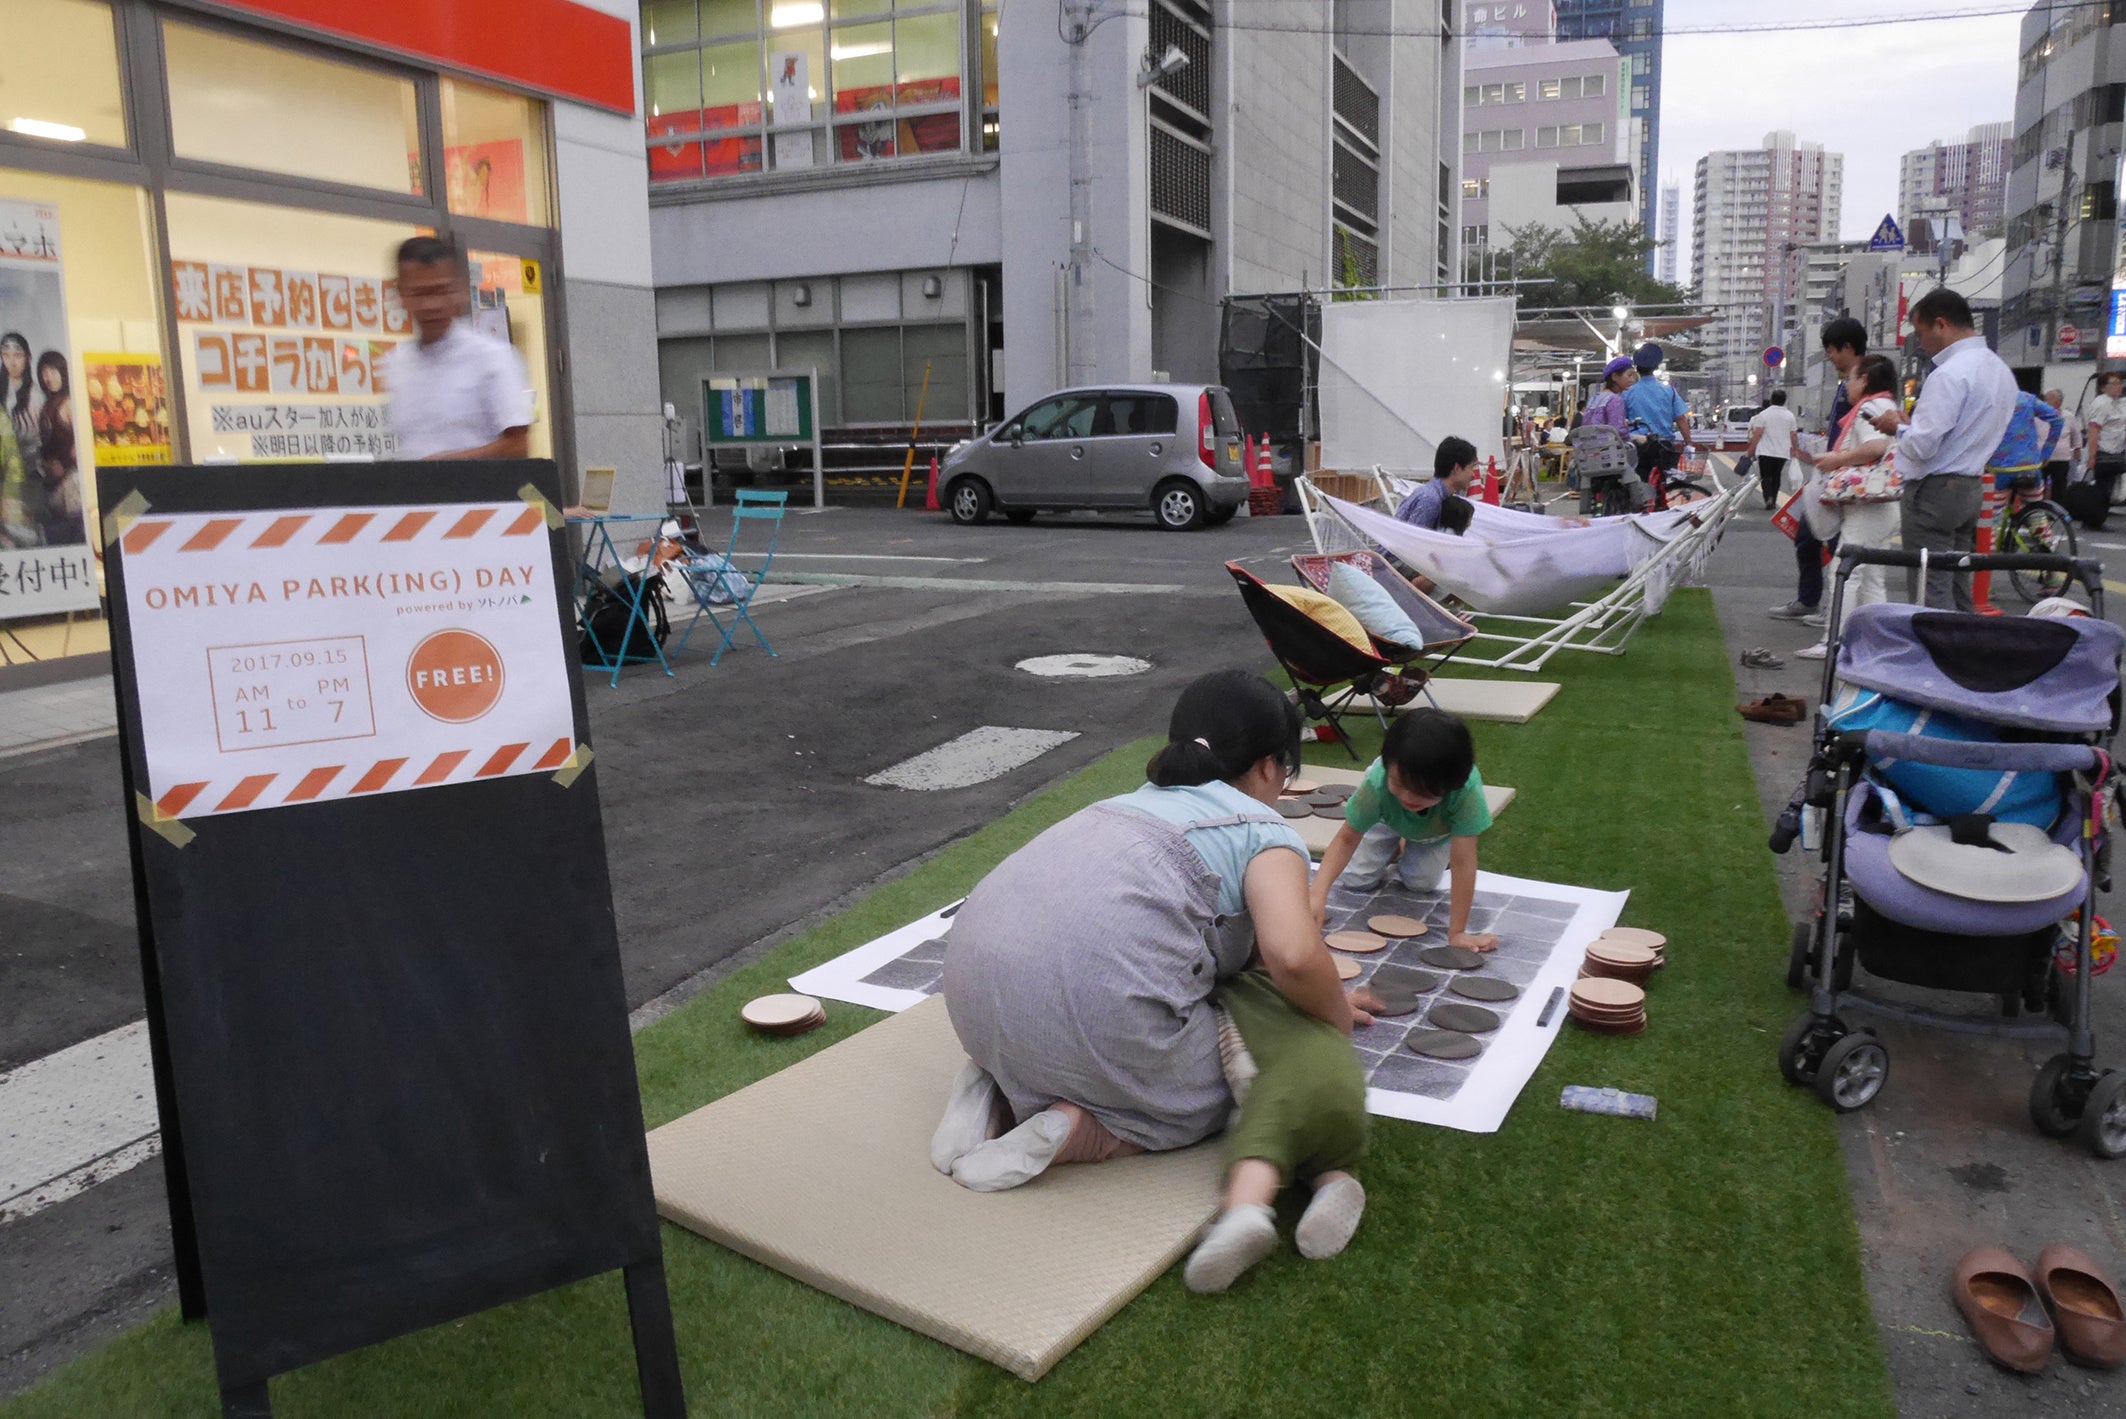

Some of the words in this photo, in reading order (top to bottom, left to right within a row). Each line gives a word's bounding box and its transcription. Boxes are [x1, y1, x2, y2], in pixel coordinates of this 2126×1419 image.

[145, 581, 268, 610] OMIYA
[282, 568, 462, 602] PARK(ING)
[476, 565, 533, 588] DAY
[396, 600, 454, 617] powered
[458, 600, 473, 611] by
[231, 650, 348, 673] 2017.09.15
[416, 664, 494, 689] FREE!
[235, 685, 270, 703] AM
[317, 677, 350, 695] PM
[236, 707, 277, 733] 11
[287, 697, 307, 710] to
[328, 700, 344, 723] 7
